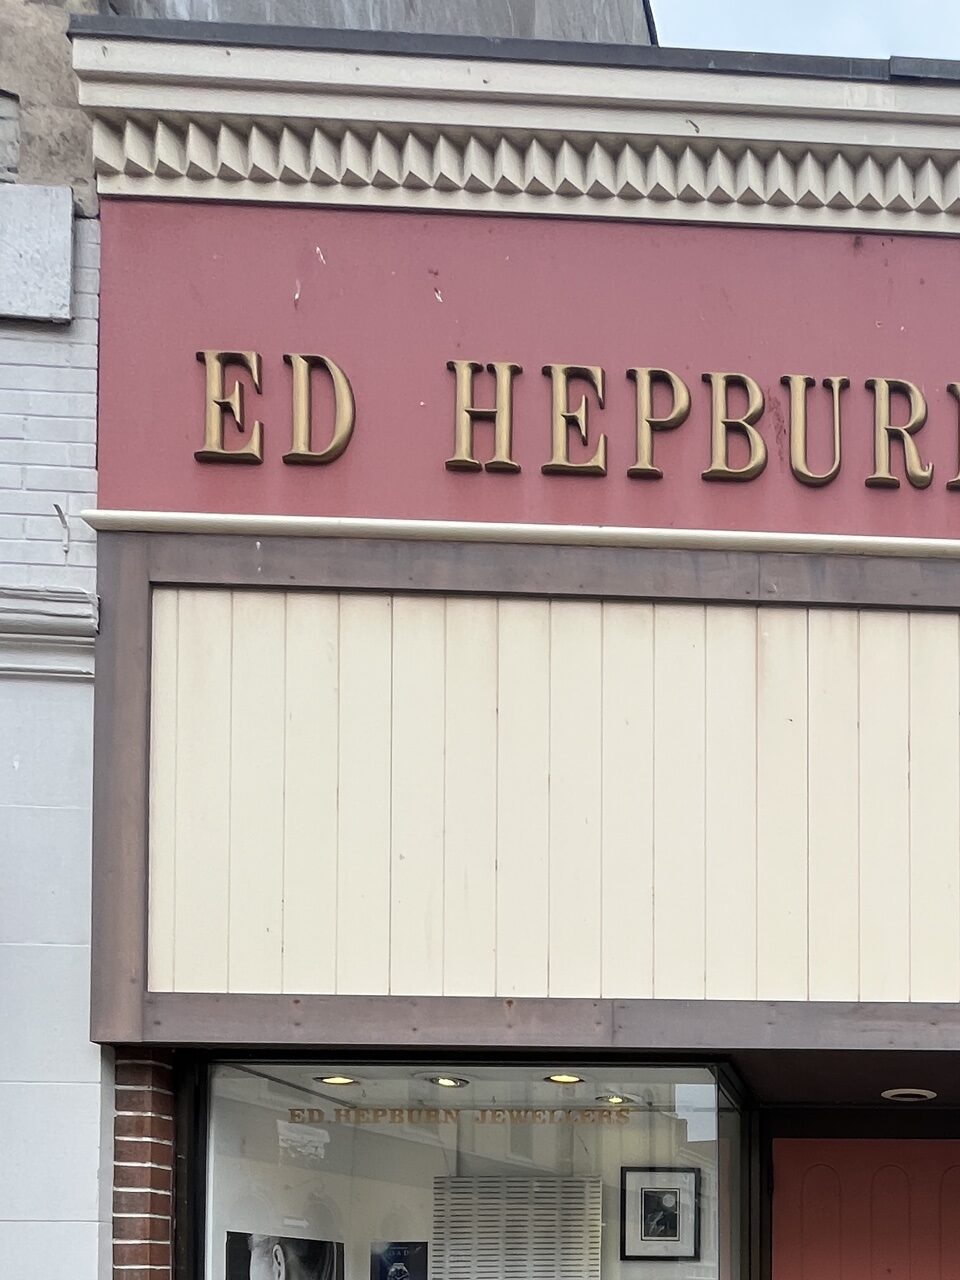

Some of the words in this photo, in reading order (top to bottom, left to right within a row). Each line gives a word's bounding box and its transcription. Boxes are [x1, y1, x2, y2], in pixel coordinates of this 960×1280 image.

[194, 350, 358, 466] ED
[334, 1107, 461, 1125] HEPBURN
[474, 1108, 631, 1125] JEWELLERS
